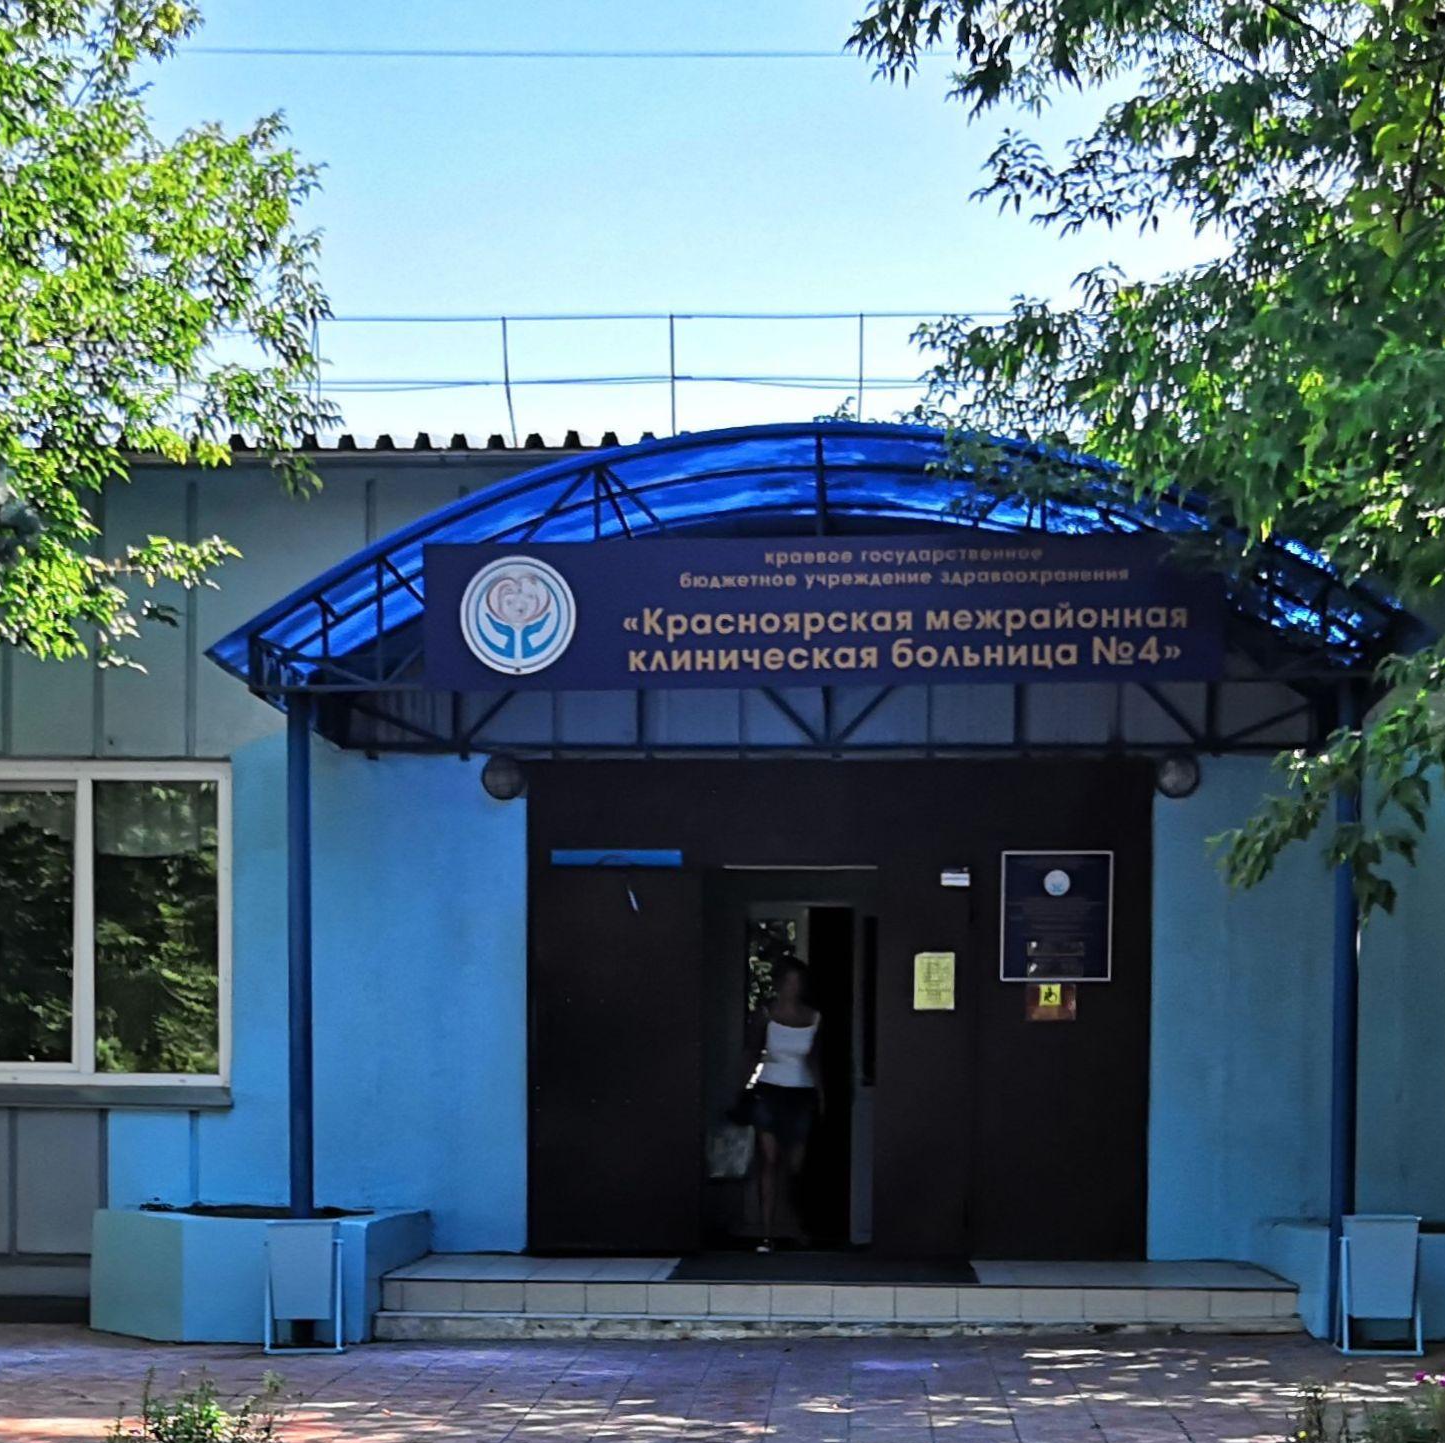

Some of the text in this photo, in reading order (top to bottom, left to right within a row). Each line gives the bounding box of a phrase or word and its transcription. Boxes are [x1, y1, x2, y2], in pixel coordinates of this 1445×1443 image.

[764, 547, 1044, 568] краевое государственное
[679, 568, 1129, 590] бюджетное учреждение здравоохранения
[622, 601, 1188, 643] «Красноярская межрайонная
[628, 635, 1182, 672] клиническая больница №4»
